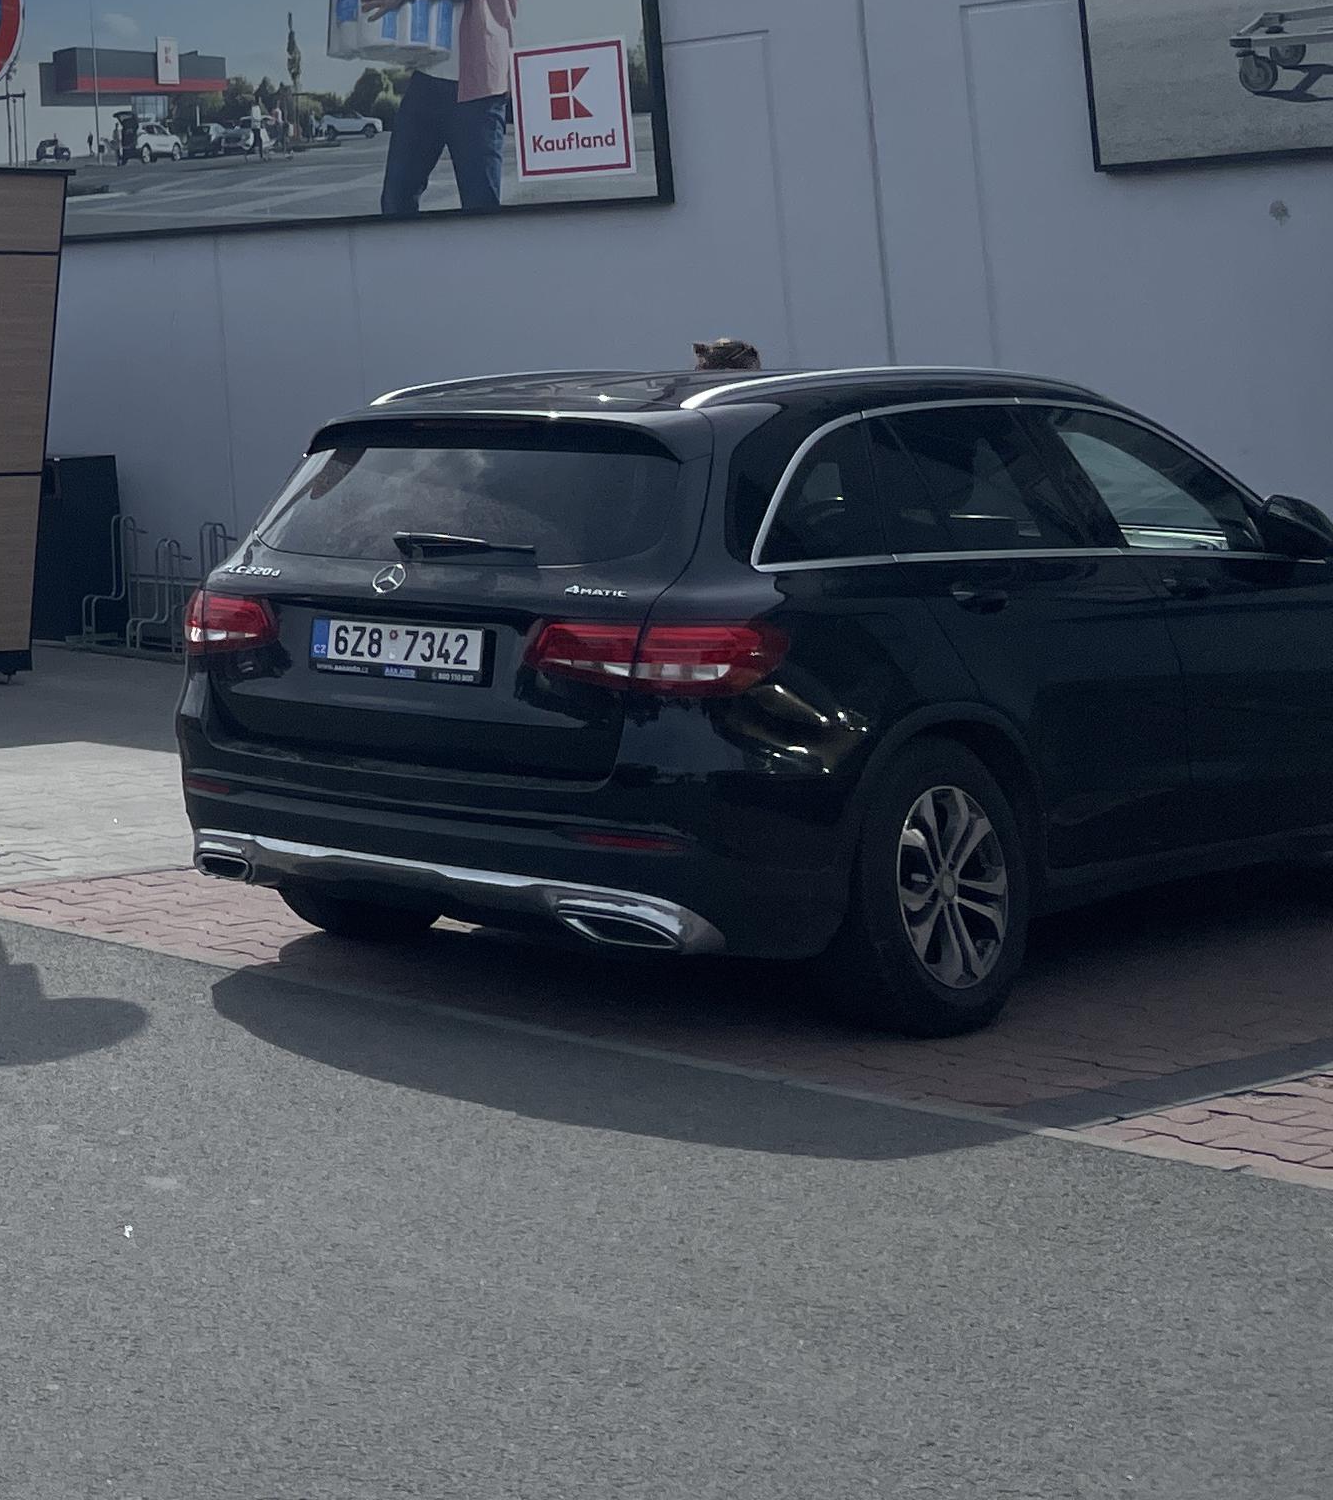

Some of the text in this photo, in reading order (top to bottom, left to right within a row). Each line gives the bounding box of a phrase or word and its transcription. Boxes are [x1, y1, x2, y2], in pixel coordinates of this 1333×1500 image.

[532, 129, 616, 153] Kaufland
[564, 585, 629, 598] 4MATIC
[334, 625, 469, 666] 6Z8 7342
